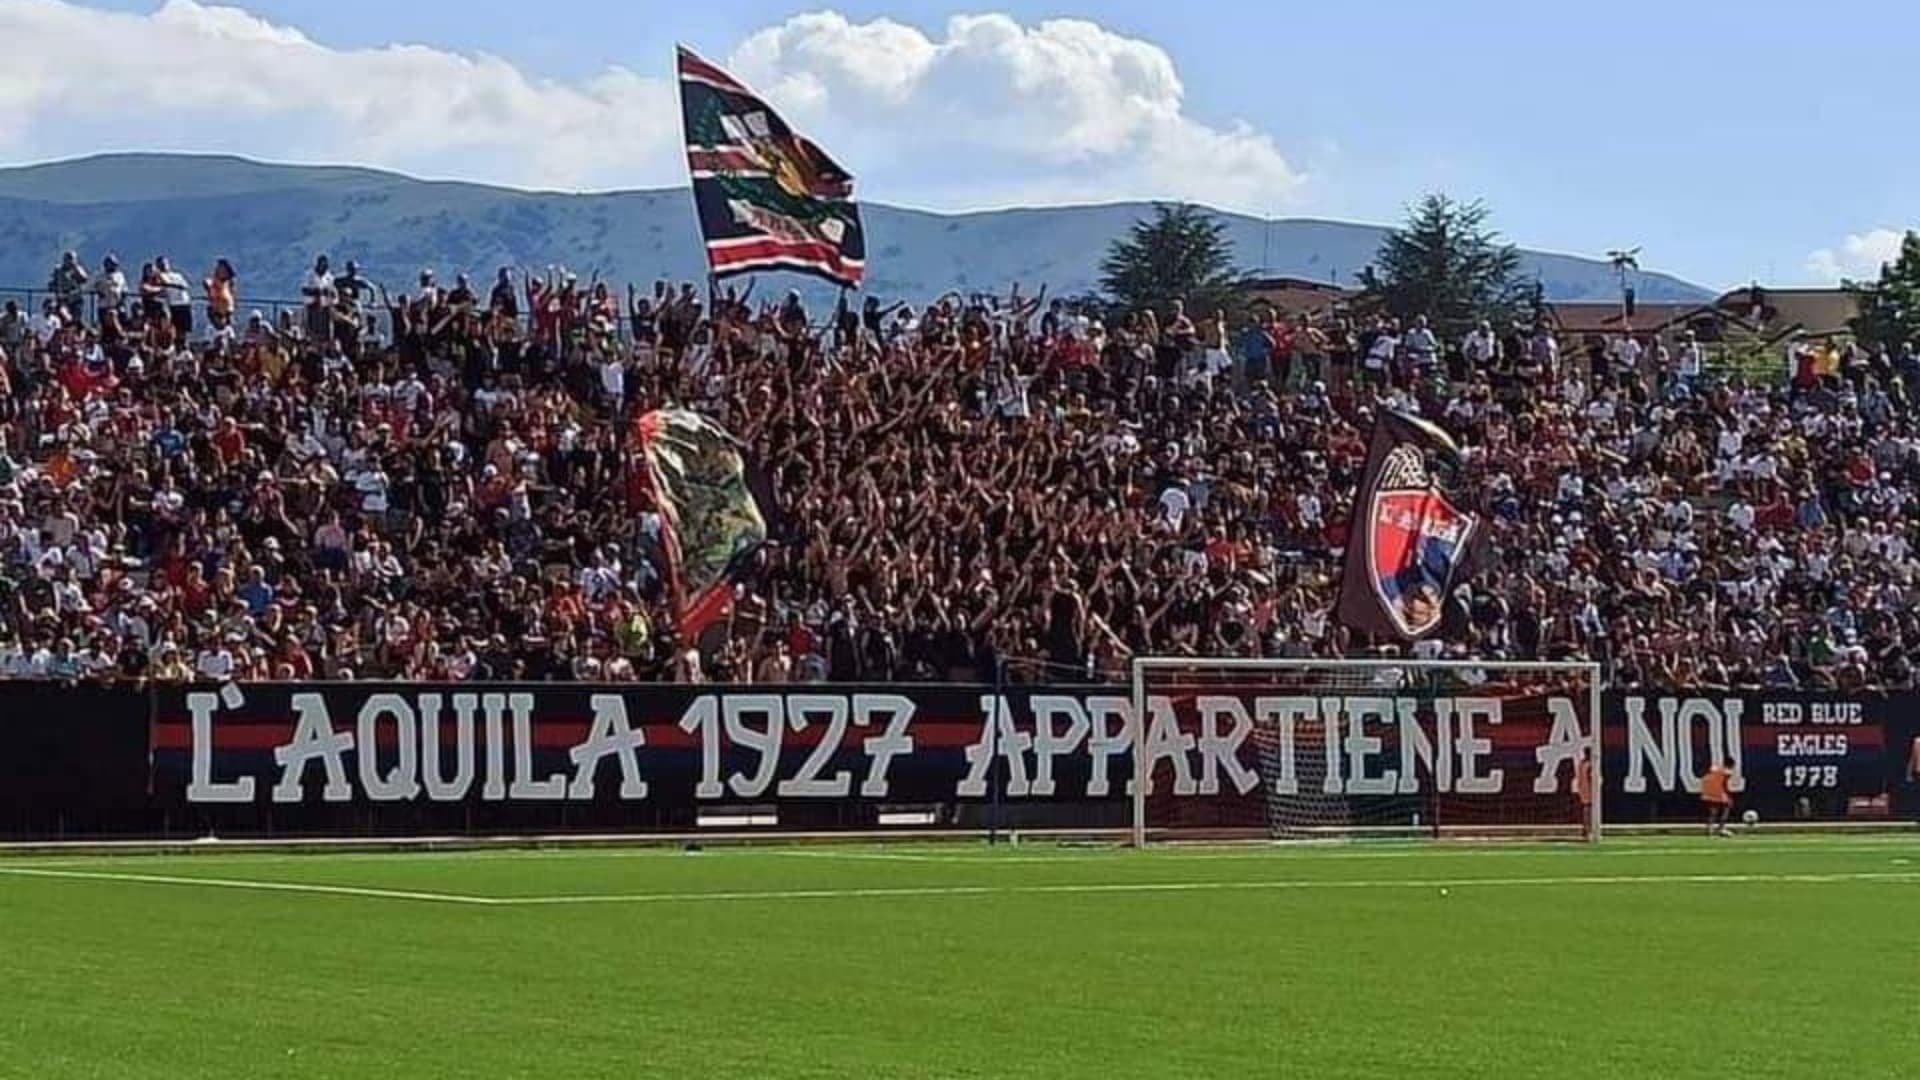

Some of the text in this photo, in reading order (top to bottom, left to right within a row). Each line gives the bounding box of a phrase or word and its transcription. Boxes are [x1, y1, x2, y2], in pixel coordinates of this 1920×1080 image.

[1763, 703, 1862, 723] RED BLUE
[186, 682, 1746, 802] L'AQUILA 1927 APPARTIENE A NOI
[1778, 735, 1848, 755] EAGLES
[1783, 765, 1839, 787] 1978
